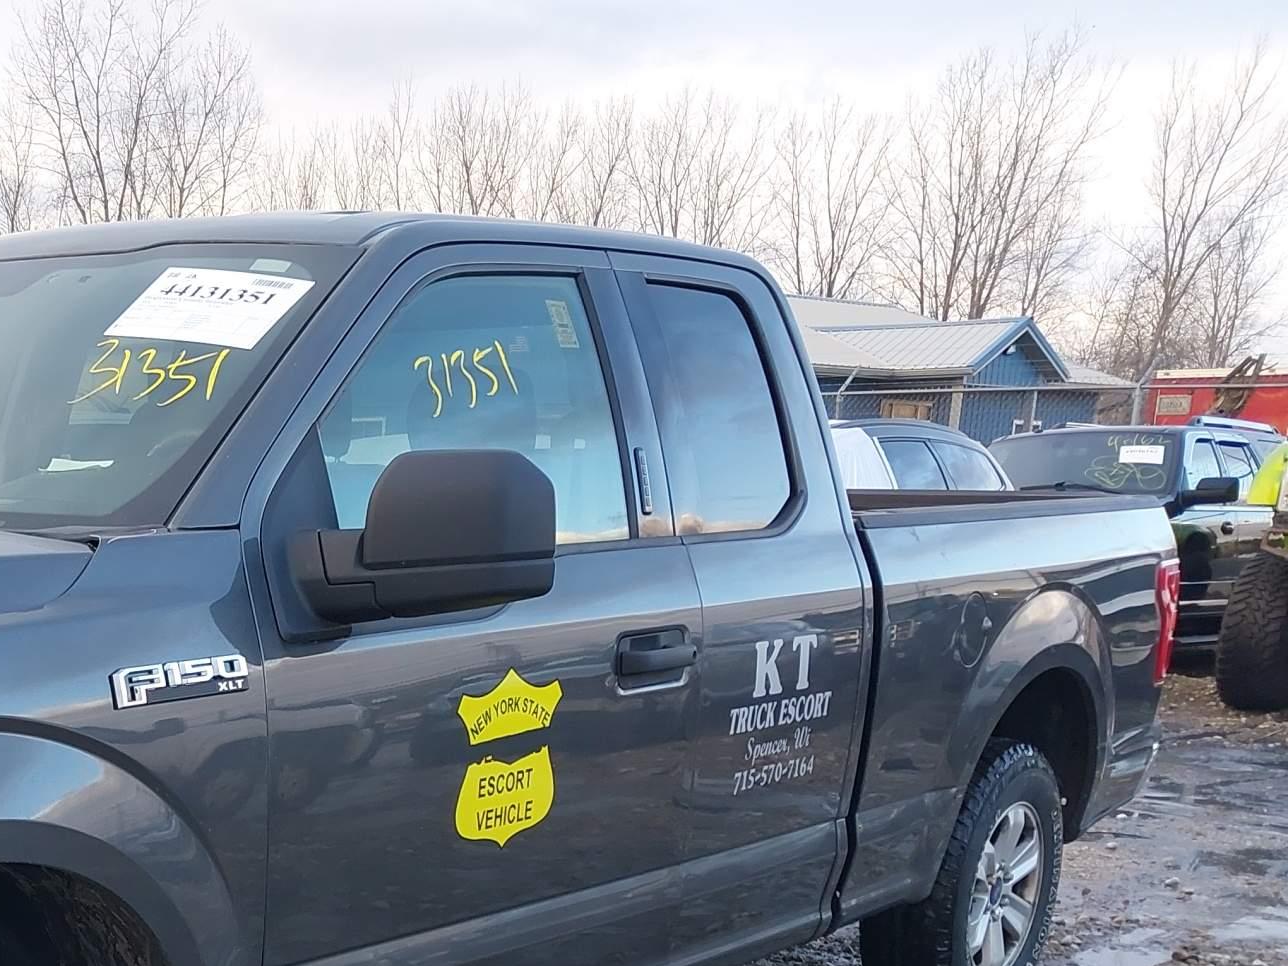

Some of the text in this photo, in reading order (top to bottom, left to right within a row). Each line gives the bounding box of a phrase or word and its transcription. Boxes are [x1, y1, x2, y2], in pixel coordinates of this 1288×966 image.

[161, 282, 278, 305] 44131351
[66, 337, 231, 408] 31351
[413, 339, 519, 418] 31351
[109, 653, 250, 709] F150
[217, 678, 245, 692] XLT
[752, 633, 818, 699] K T
[469, 696, 551, 740] NEW YORK STATE
[729, 690, 833, 736] TRUCK ESCORT
[744, 726, 813, 767] Spencer, Wi
[478, 767, 534, 799] ESCORT
[733, 754, 815, 796] 715-570-7164
[476, 800, 534, 832] VEHICLE
